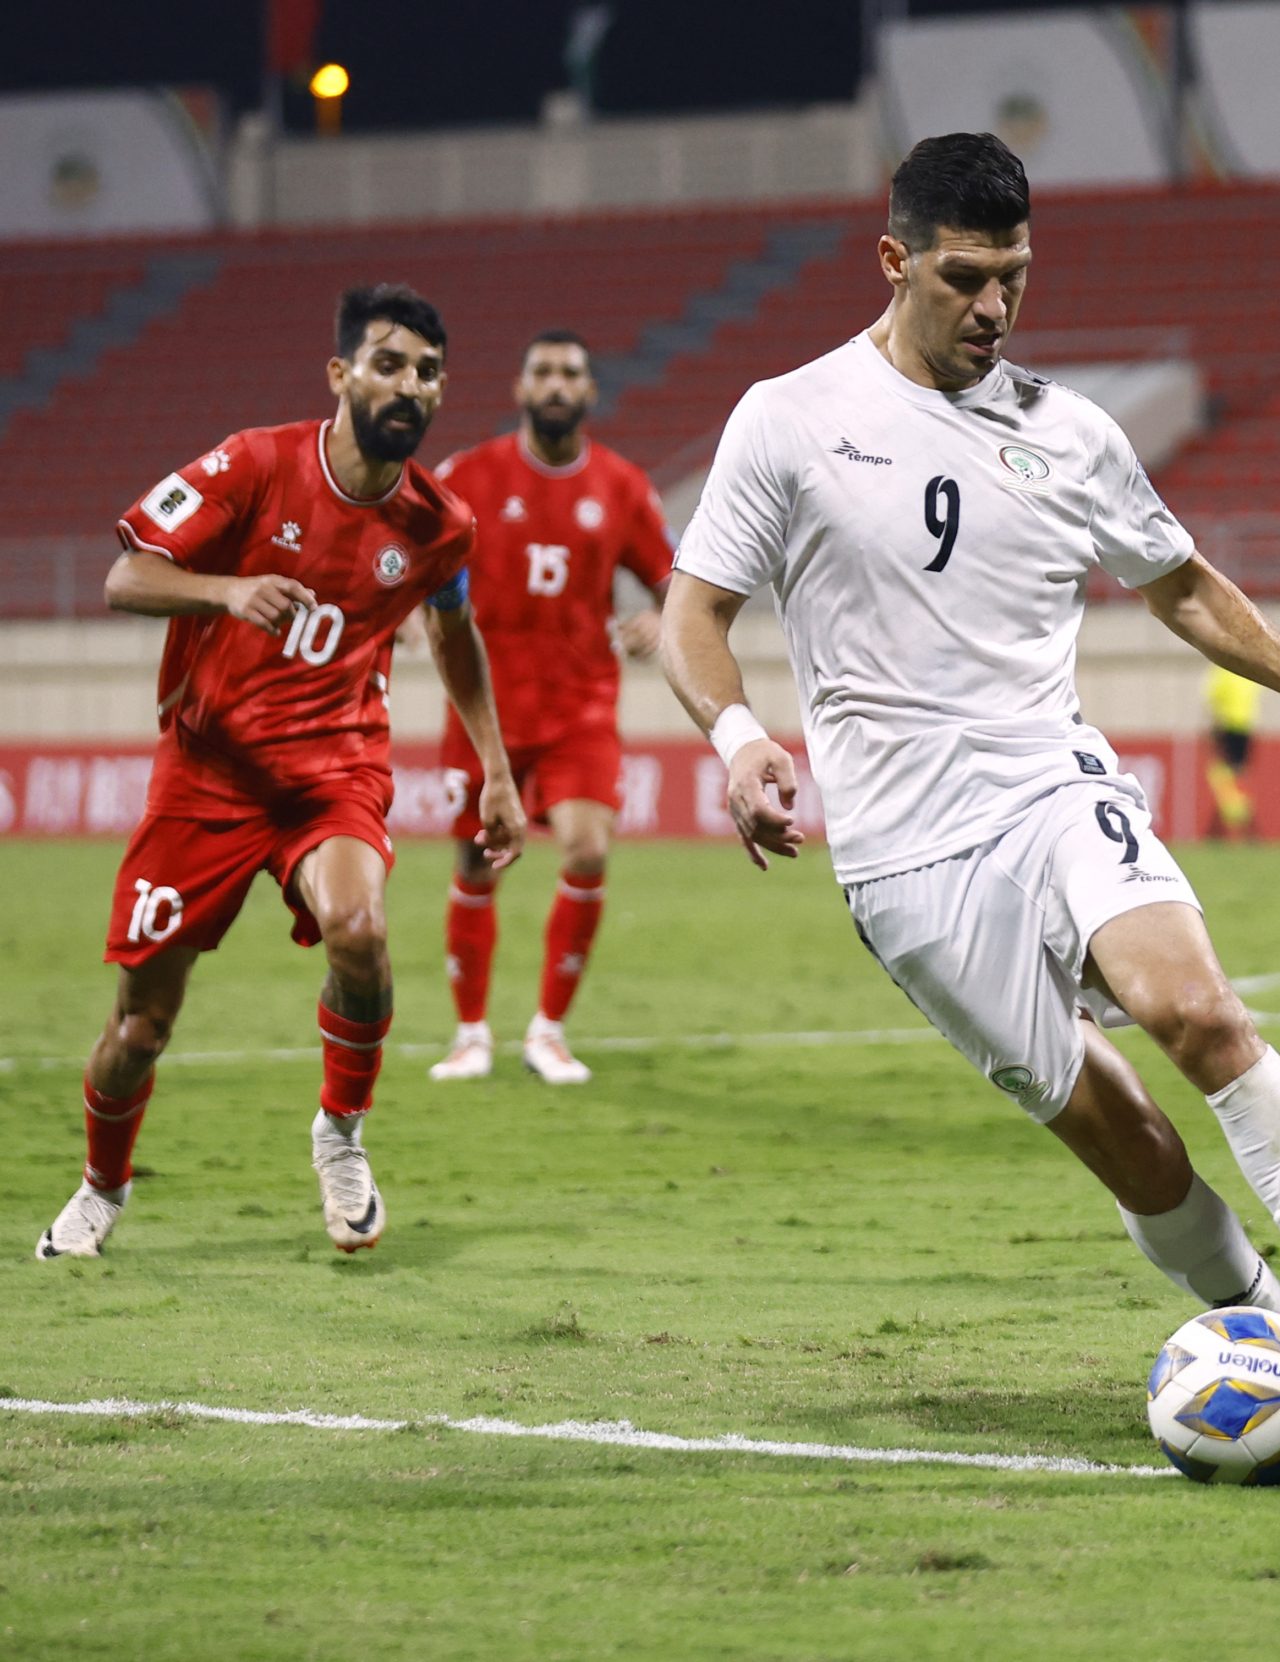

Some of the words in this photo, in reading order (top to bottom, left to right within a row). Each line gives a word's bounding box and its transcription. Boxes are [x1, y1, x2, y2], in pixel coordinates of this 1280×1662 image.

[848, 452, 892, 466] tempo
[924, 475, 960, 572] 9
[526, 544, 570, 596] 15
[282, 601, 345, 667] 10
[1095, 800, 1139, 865] 9
[127, 877, 184, 943] 10
